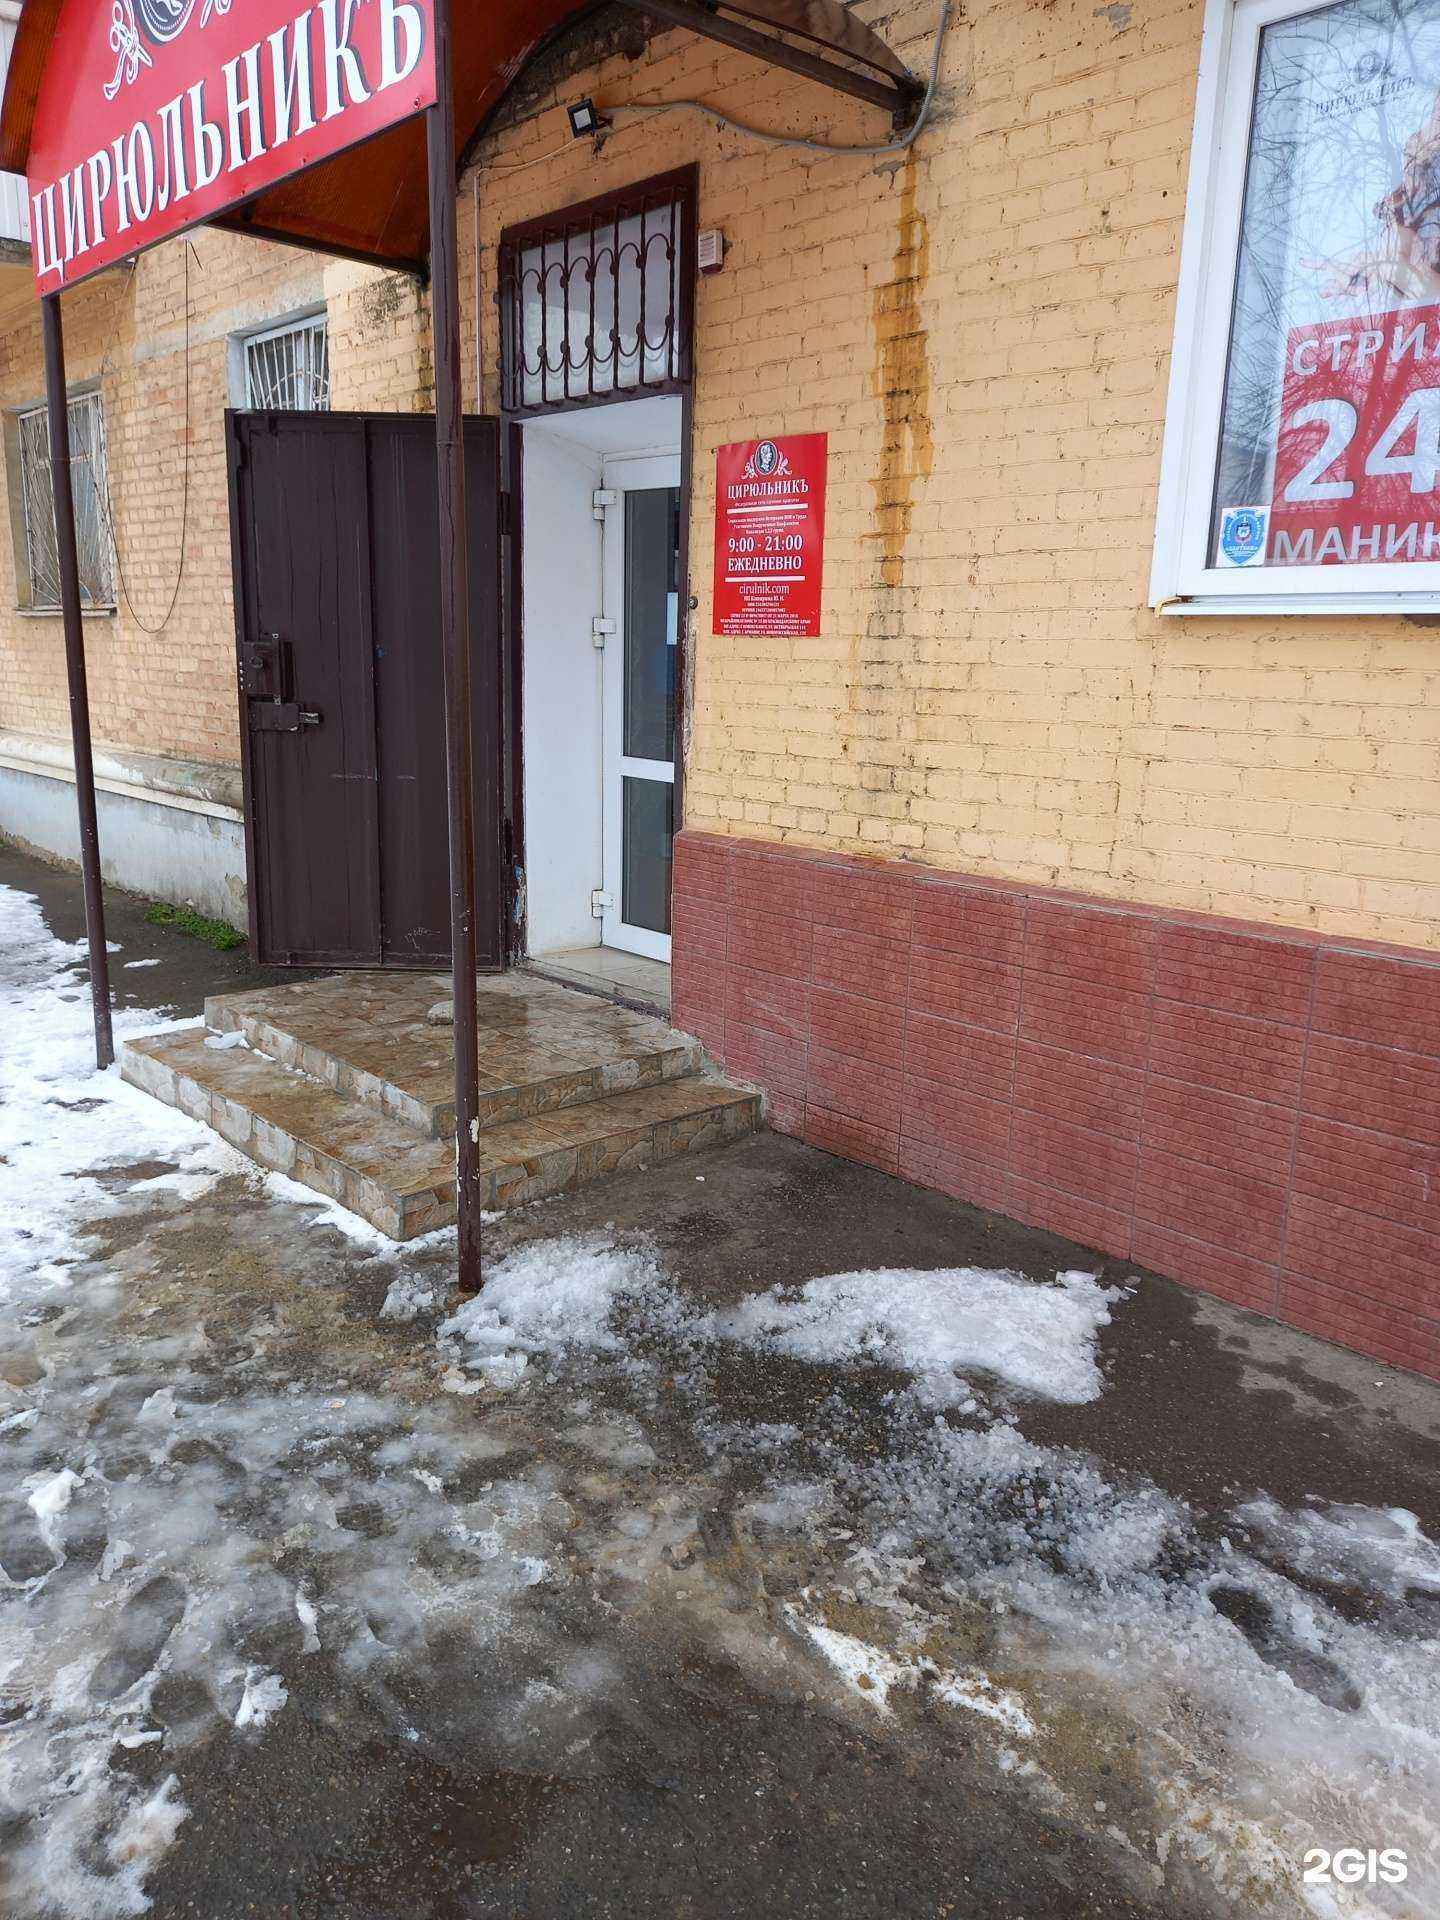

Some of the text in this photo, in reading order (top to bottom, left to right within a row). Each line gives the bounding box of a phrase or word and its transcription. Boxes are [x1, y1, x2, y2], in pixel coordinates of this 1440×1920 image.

[32, 0, 424, 283] ЦИРЮЛЬНИКЪ
[1292, 319, 1440, 376] СТРИ
[727, 479, 809, 500] ЦИРЮЛЬНИКЪ
[728, 536, 755, 552] 9:00
[764, 534, 803, 551] 21:00
[728, 555, 803, 573] ЕЖЕДНЕВНО
[739, 582, 790, 595] cirulnik.com
